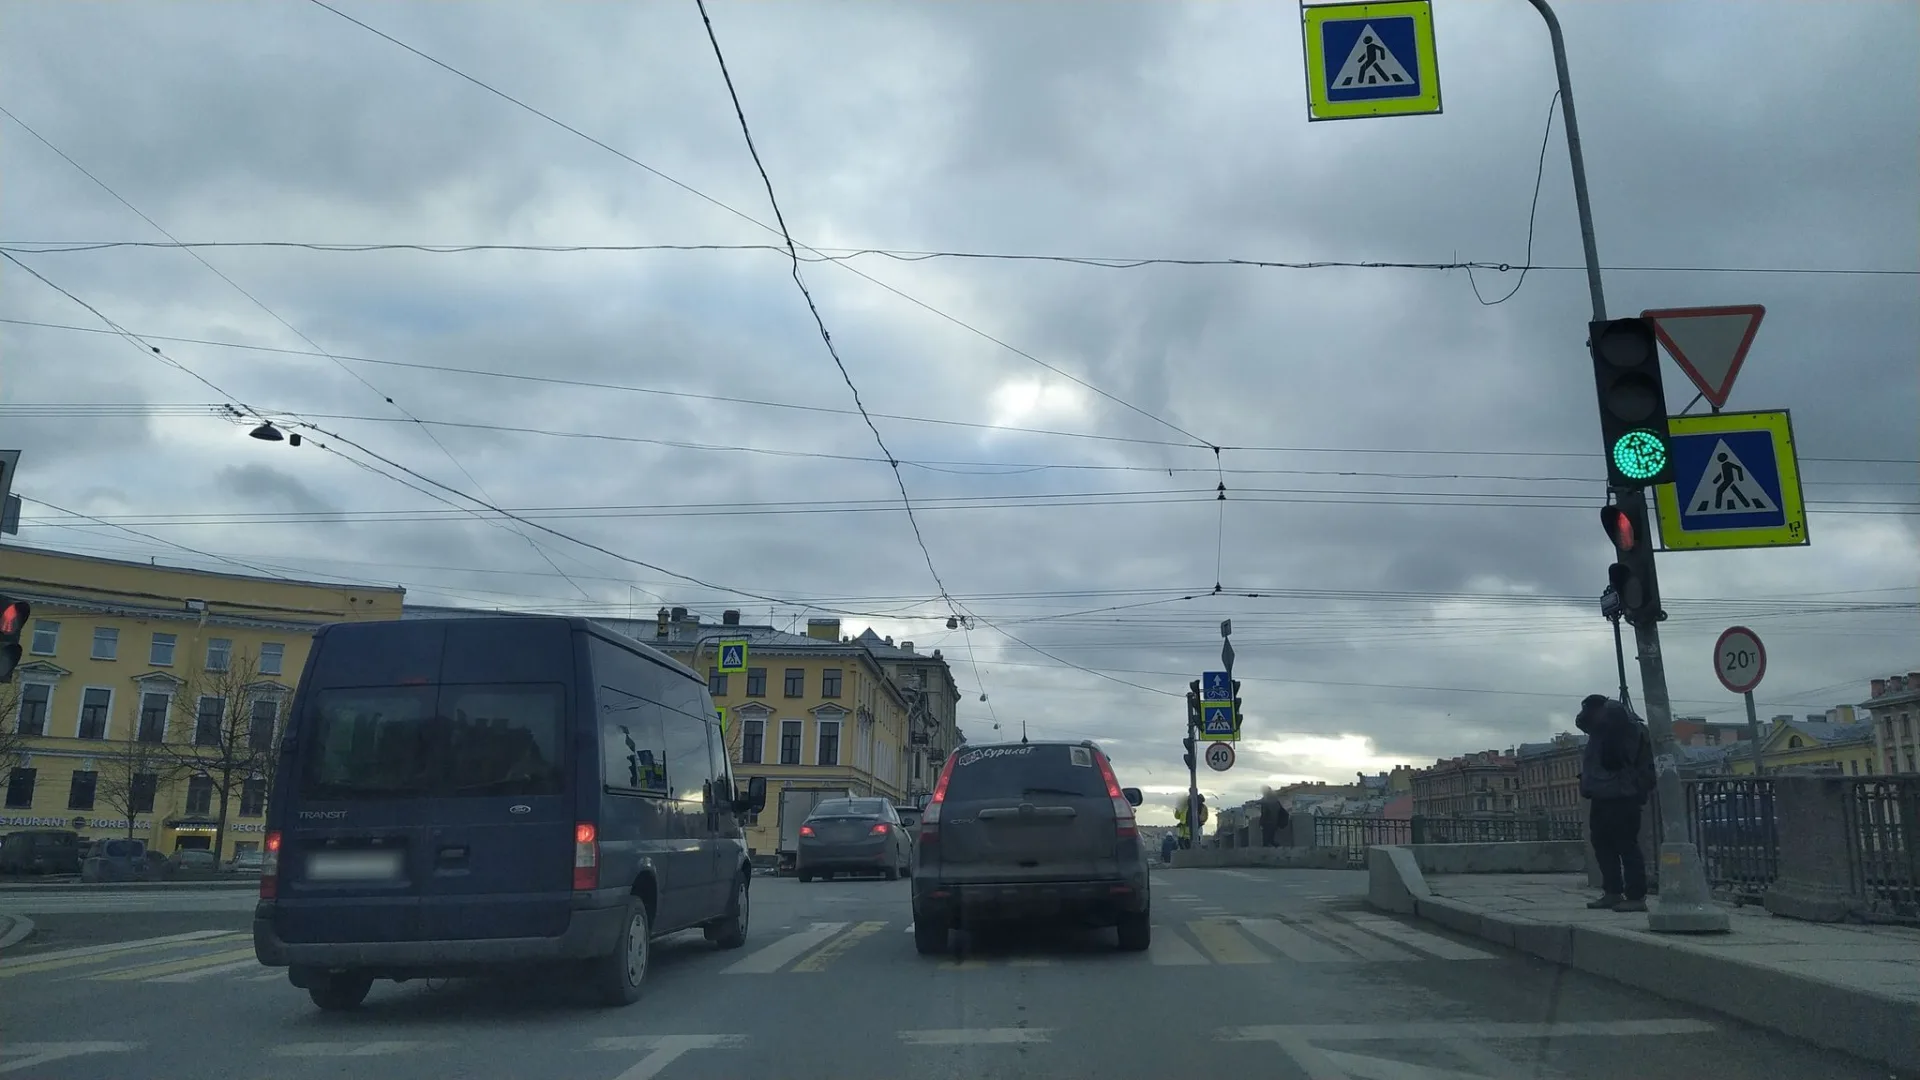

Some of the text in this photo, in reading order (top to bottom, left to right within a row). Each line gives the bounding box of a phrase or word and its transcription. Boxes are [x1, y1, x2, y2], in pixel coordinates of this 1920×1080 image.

[984, 746, 1035, 757] Сурикат
[1212, 751, 1228, 762] 40
[299, 810, 348, 820] TRANSIT
